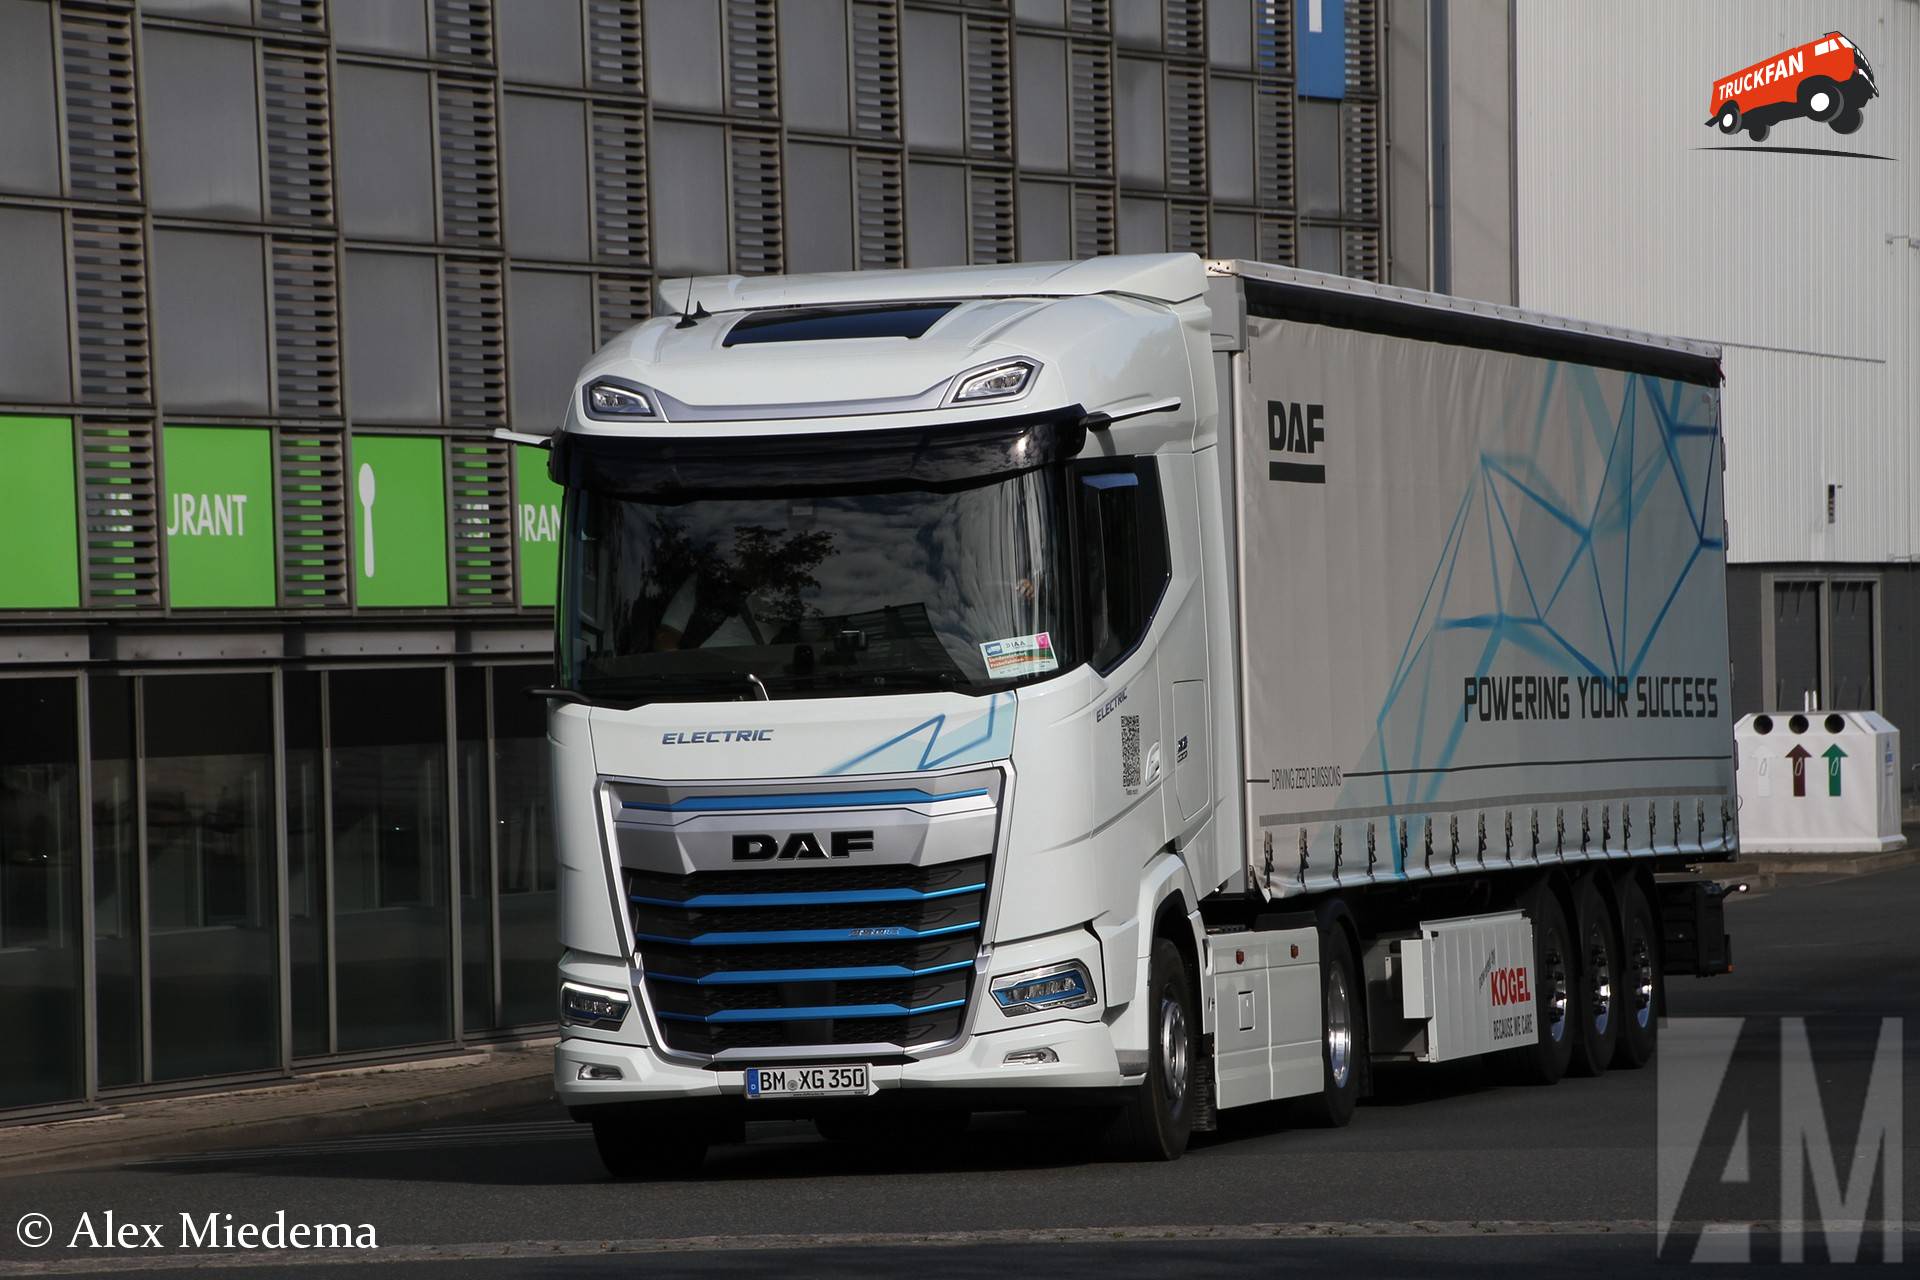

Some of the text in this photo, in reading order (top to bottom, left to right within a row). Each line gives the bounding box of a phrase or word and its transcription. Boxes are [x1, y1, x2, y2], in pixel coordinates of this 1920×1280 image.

[1267, 400, 1325, 454] DAF
[1096, 687, 1128, 723] ELECTRIC
[1464, 675, 1718, 722] POWERING YOUR SUCCESS
[661, 729, 775, 745] ELECTRIC
[1271, 765, 1342, 790] DRIVING ZERO EMISSIONS
[732, 829, 875, 863] DAF
[1490, 967, 1531, 1007] KÖGEL
[1493, 1013, 1533, 1040] BECAUSE WE CARE
[760, 1071, 786, 1091] BM
[799, 1070, 824, 1090] XG
[828, 1068, 865, 1088] 350
